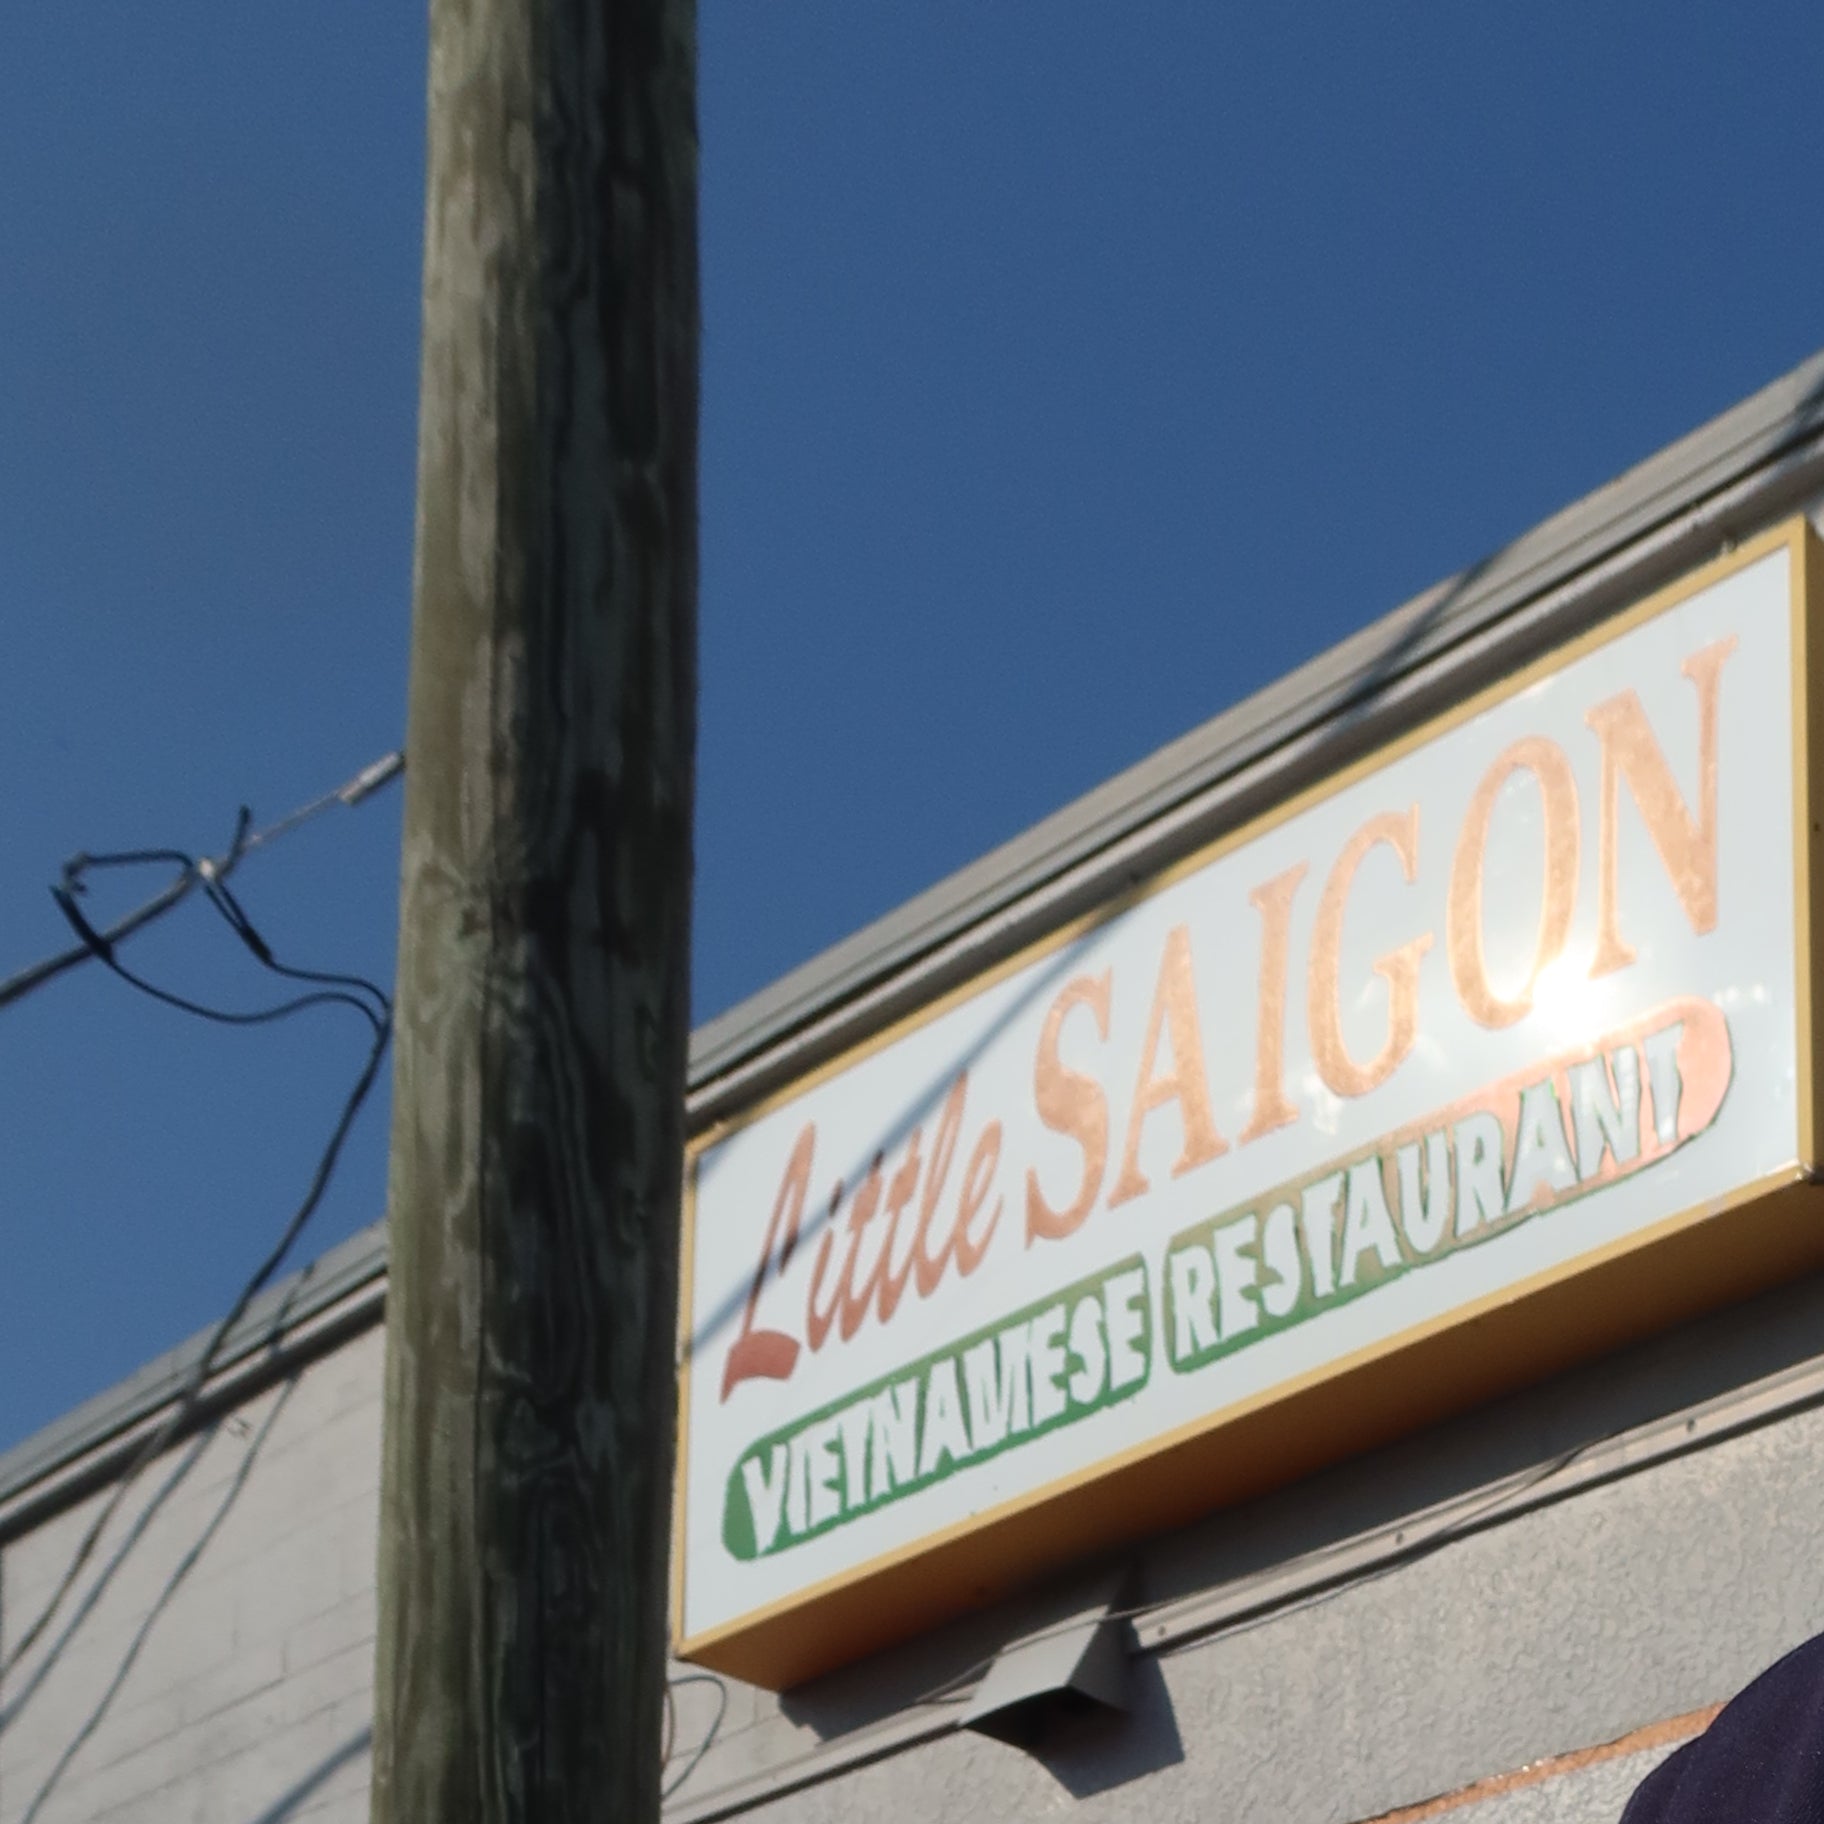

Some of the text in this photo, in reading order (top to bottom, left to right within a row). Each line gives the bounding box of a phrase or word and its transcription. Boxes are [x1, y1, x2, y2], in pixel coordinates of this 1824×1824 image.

[719, 634, 1740, 1405] Little SAIGON
[740, 1019, 1686, 1557] VIETNAMESE RESTAURANT
